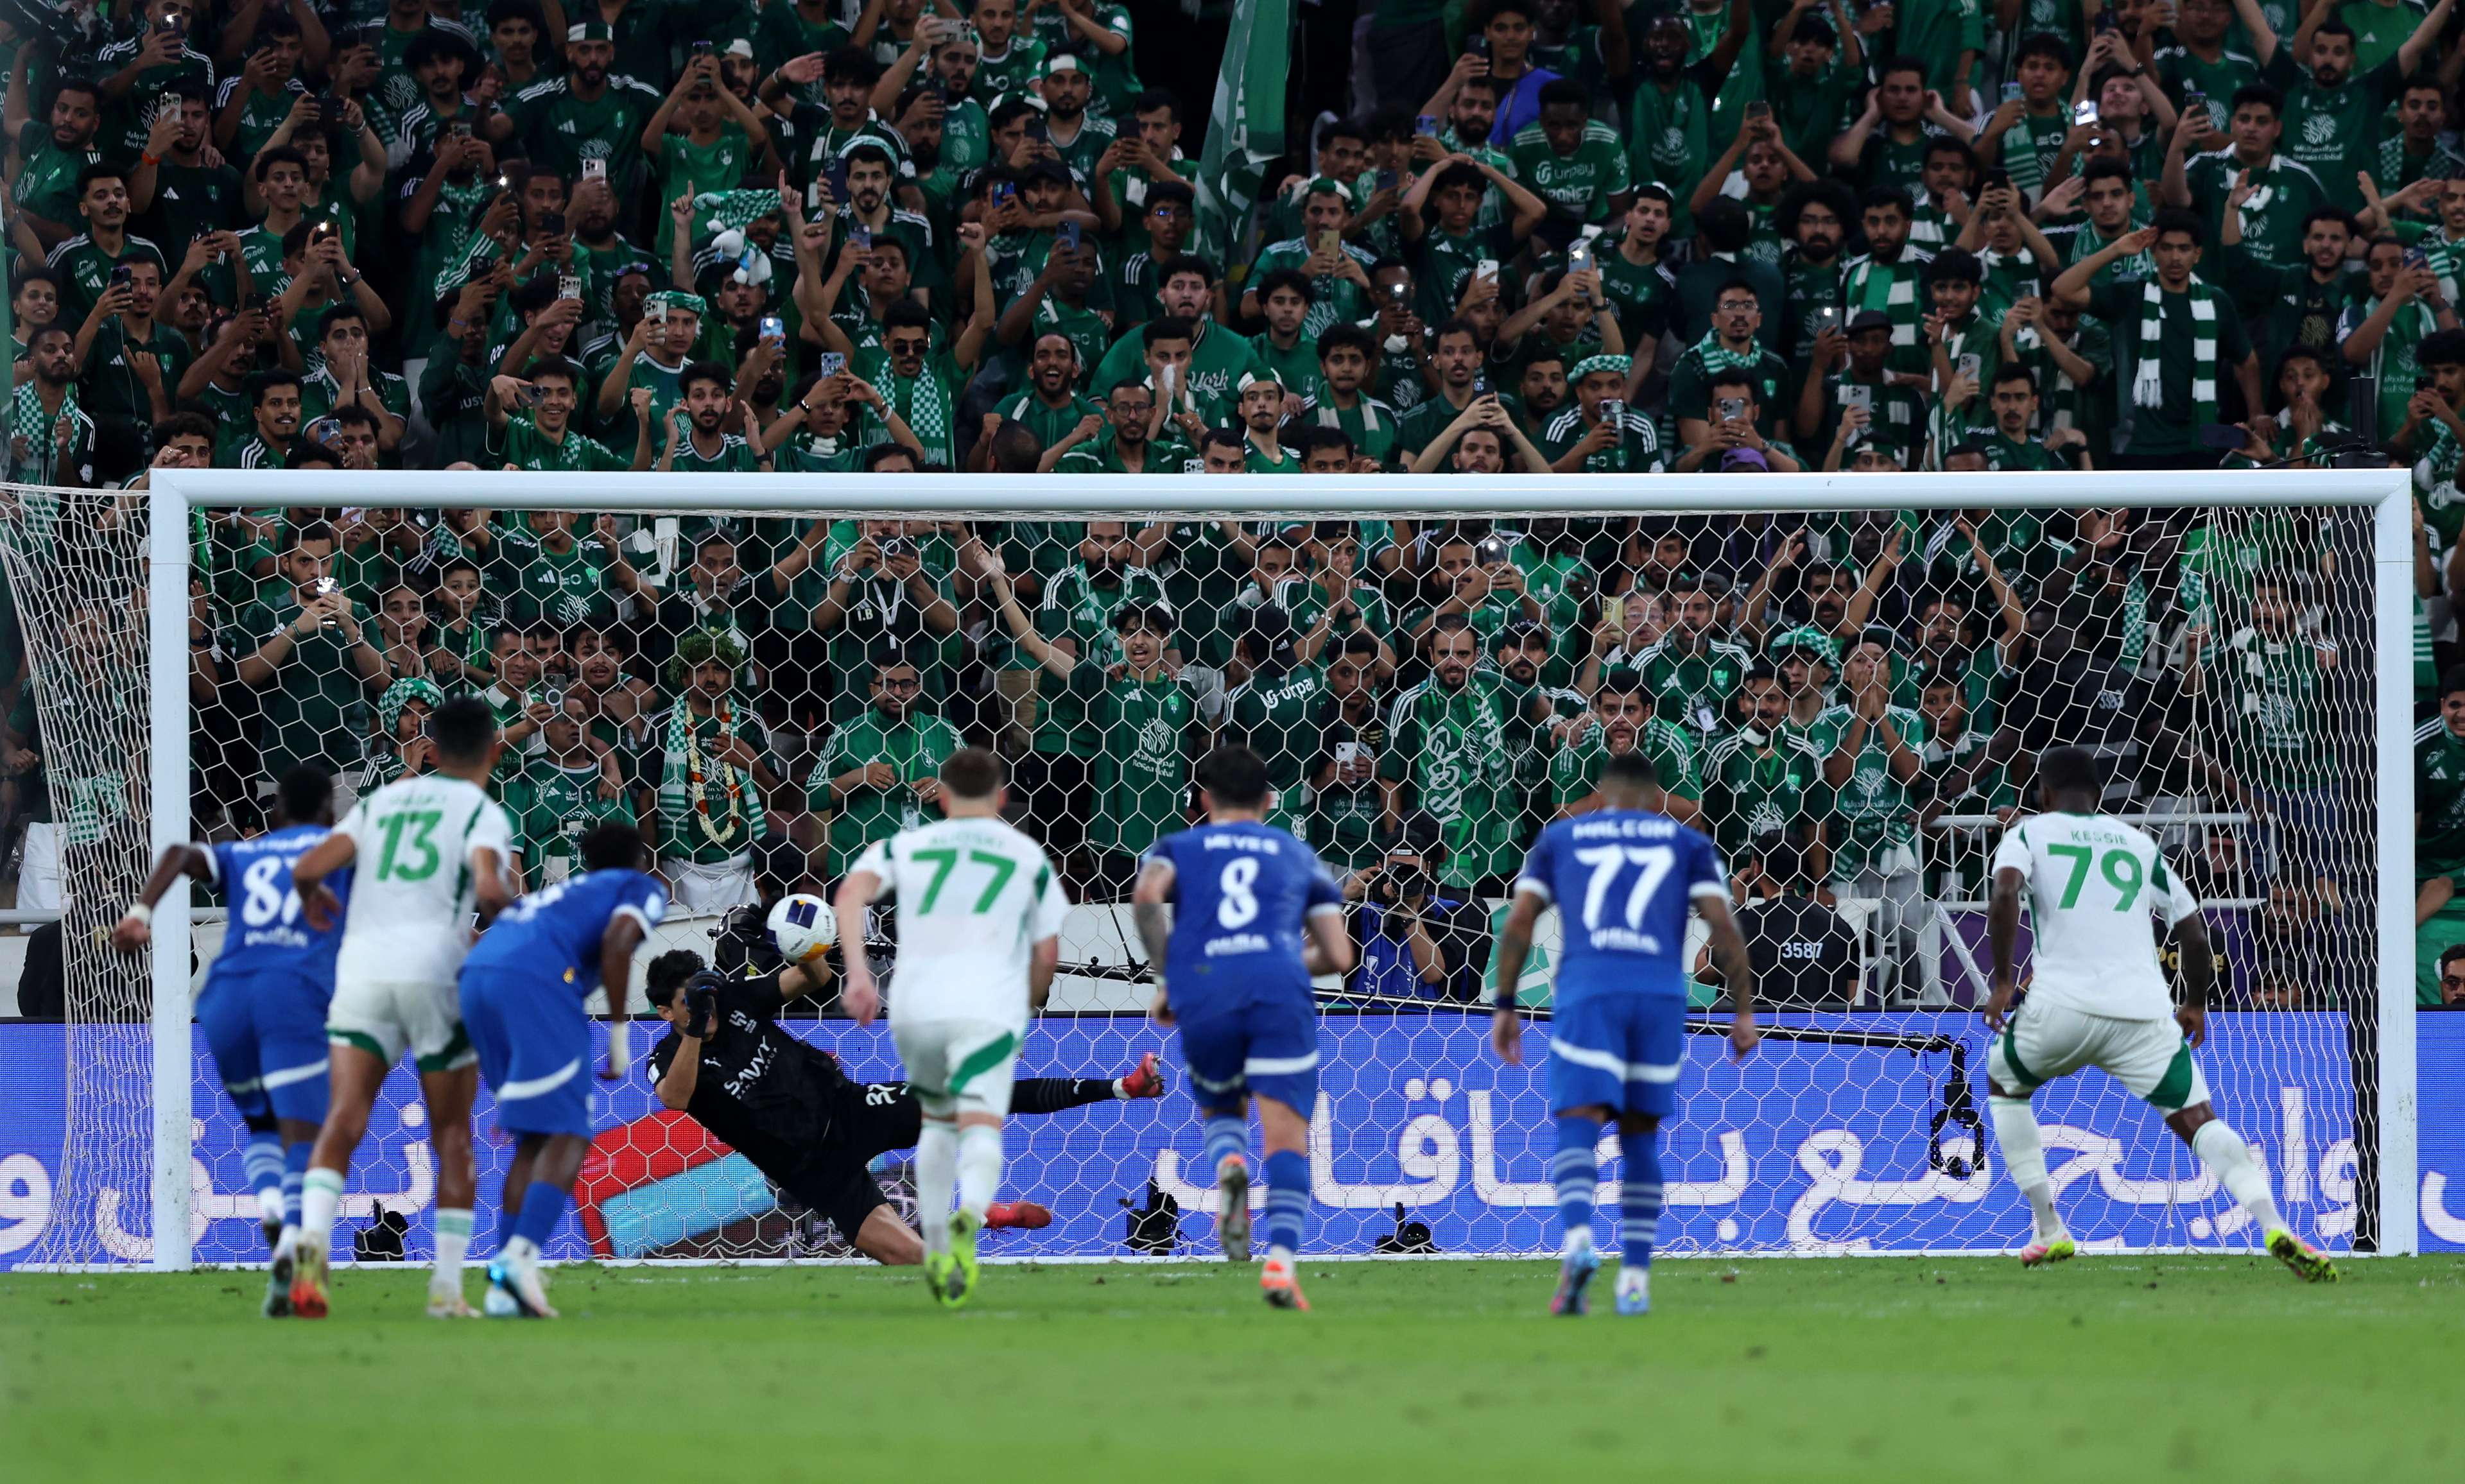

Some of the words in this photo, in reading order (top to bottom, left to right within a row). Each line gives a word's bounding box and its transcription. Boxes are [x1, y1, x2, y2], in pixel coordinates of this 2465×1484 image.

[1283, 677, 1316, 700] urpay
[377, 811, 443, 881] 13
[2071, 831, 2127, 845] KESSIE
[912, 848, 1016, 916] 77
[1218, 856, 1260, 929] 8
[1574, 843, 1676, 931] 77
[2047, 843, 2142, 912] 79
[1782, 943, 1823, 958] 3587
[723, 1035, 770, 1095] SAVVY
